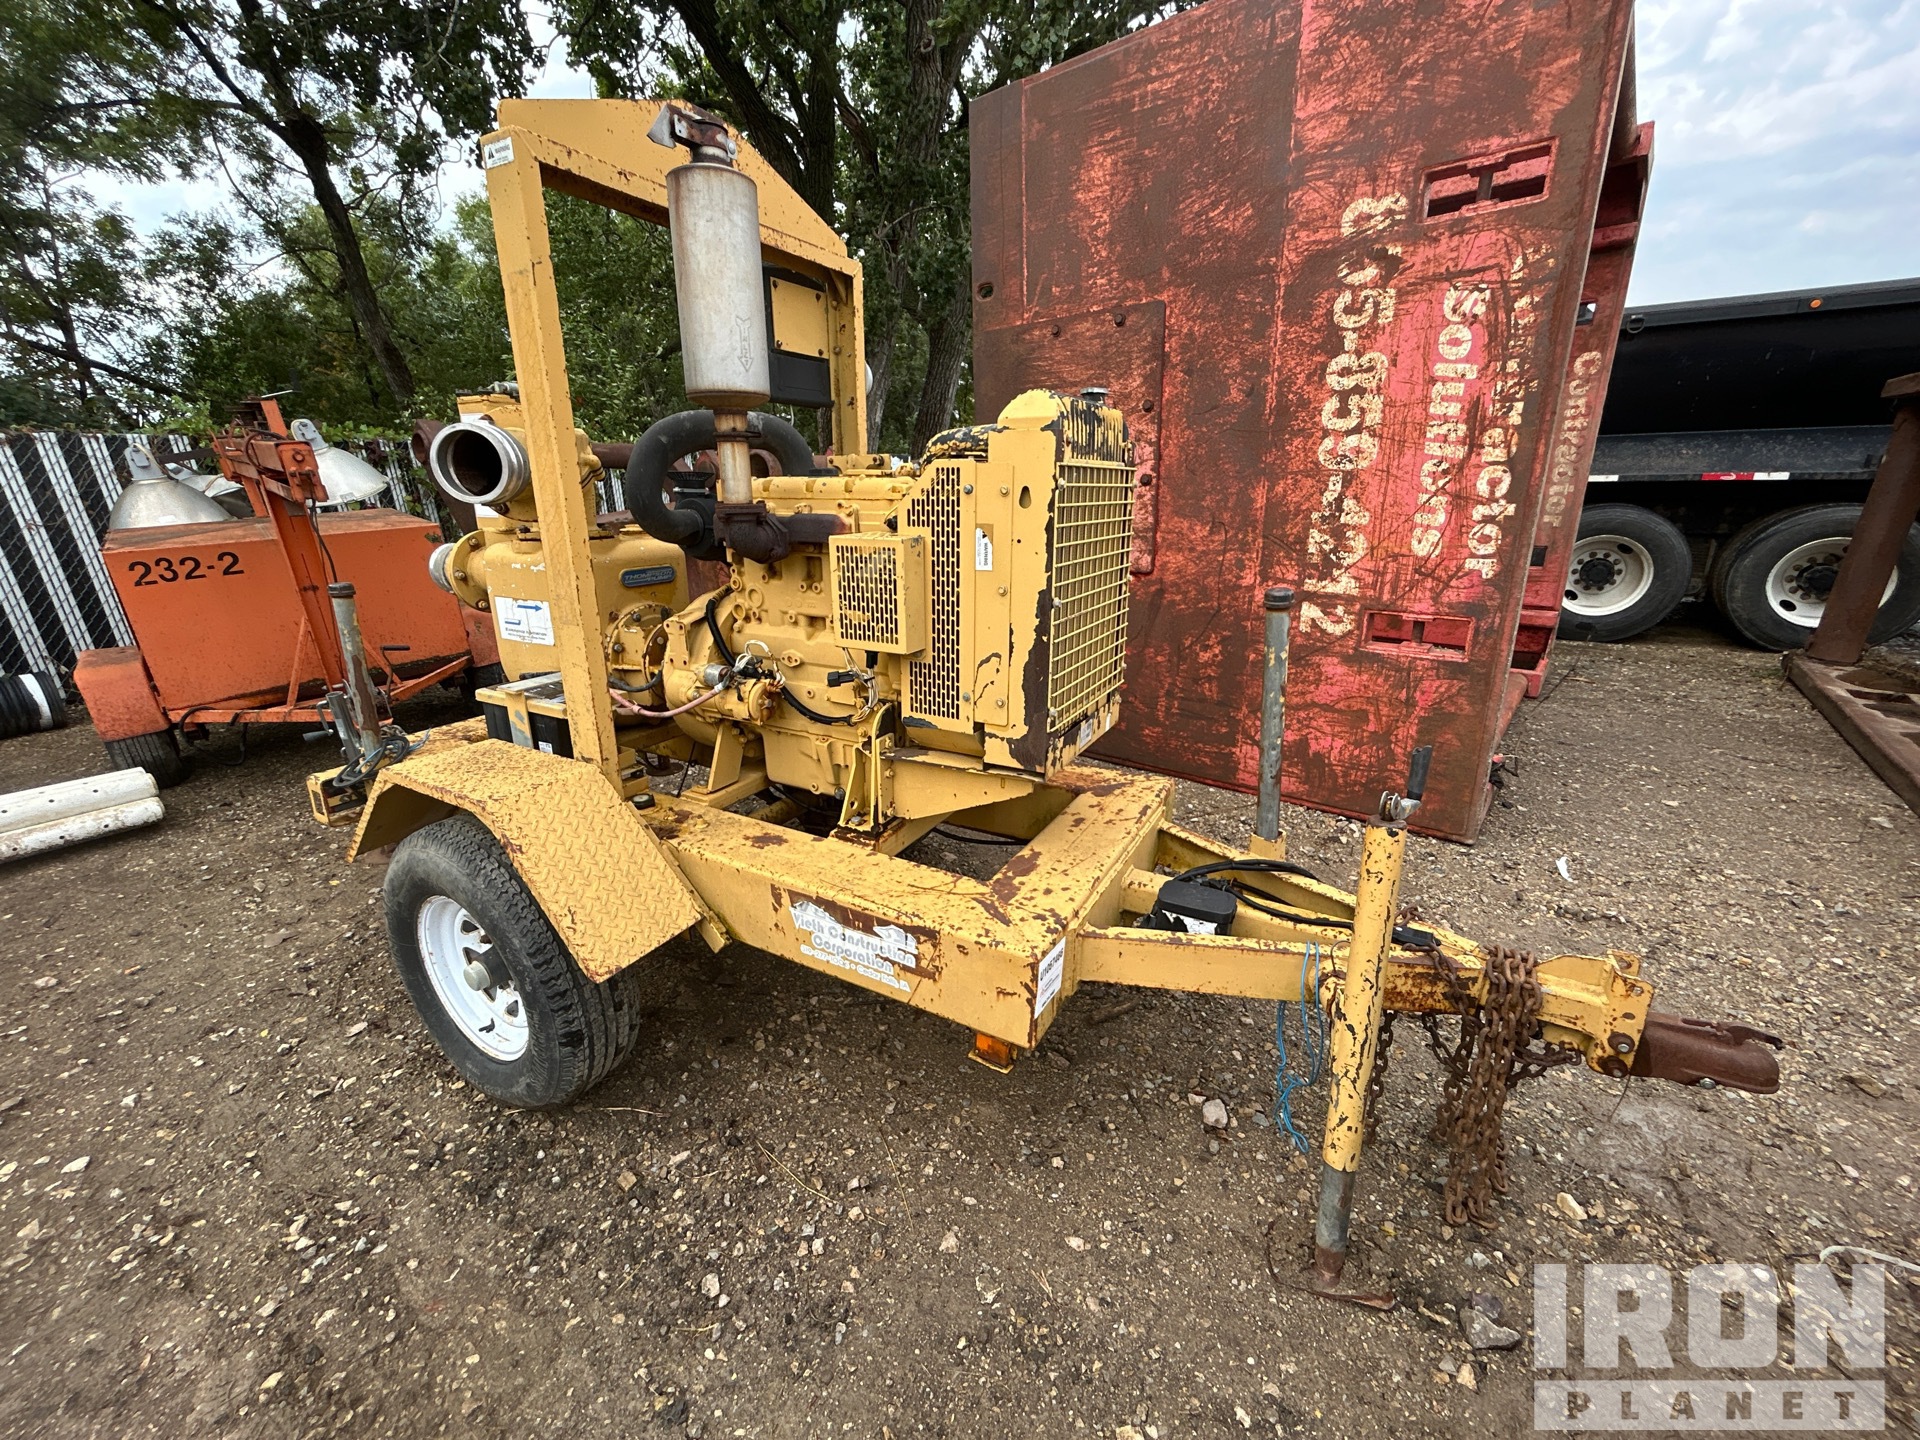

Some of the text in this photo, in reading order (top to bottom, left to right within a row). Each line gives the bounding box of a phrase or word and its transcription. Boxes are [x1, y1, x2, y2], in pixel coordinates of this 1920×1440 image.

[1411, 281, 1492, 559] Solutions
[1543, 350, 1603, 528] Contractor
[128, 551, 245, 587] 232-2
[793, 912, 914, 965] Vieth Construction
[813, 934, 892, 973] Corporation
